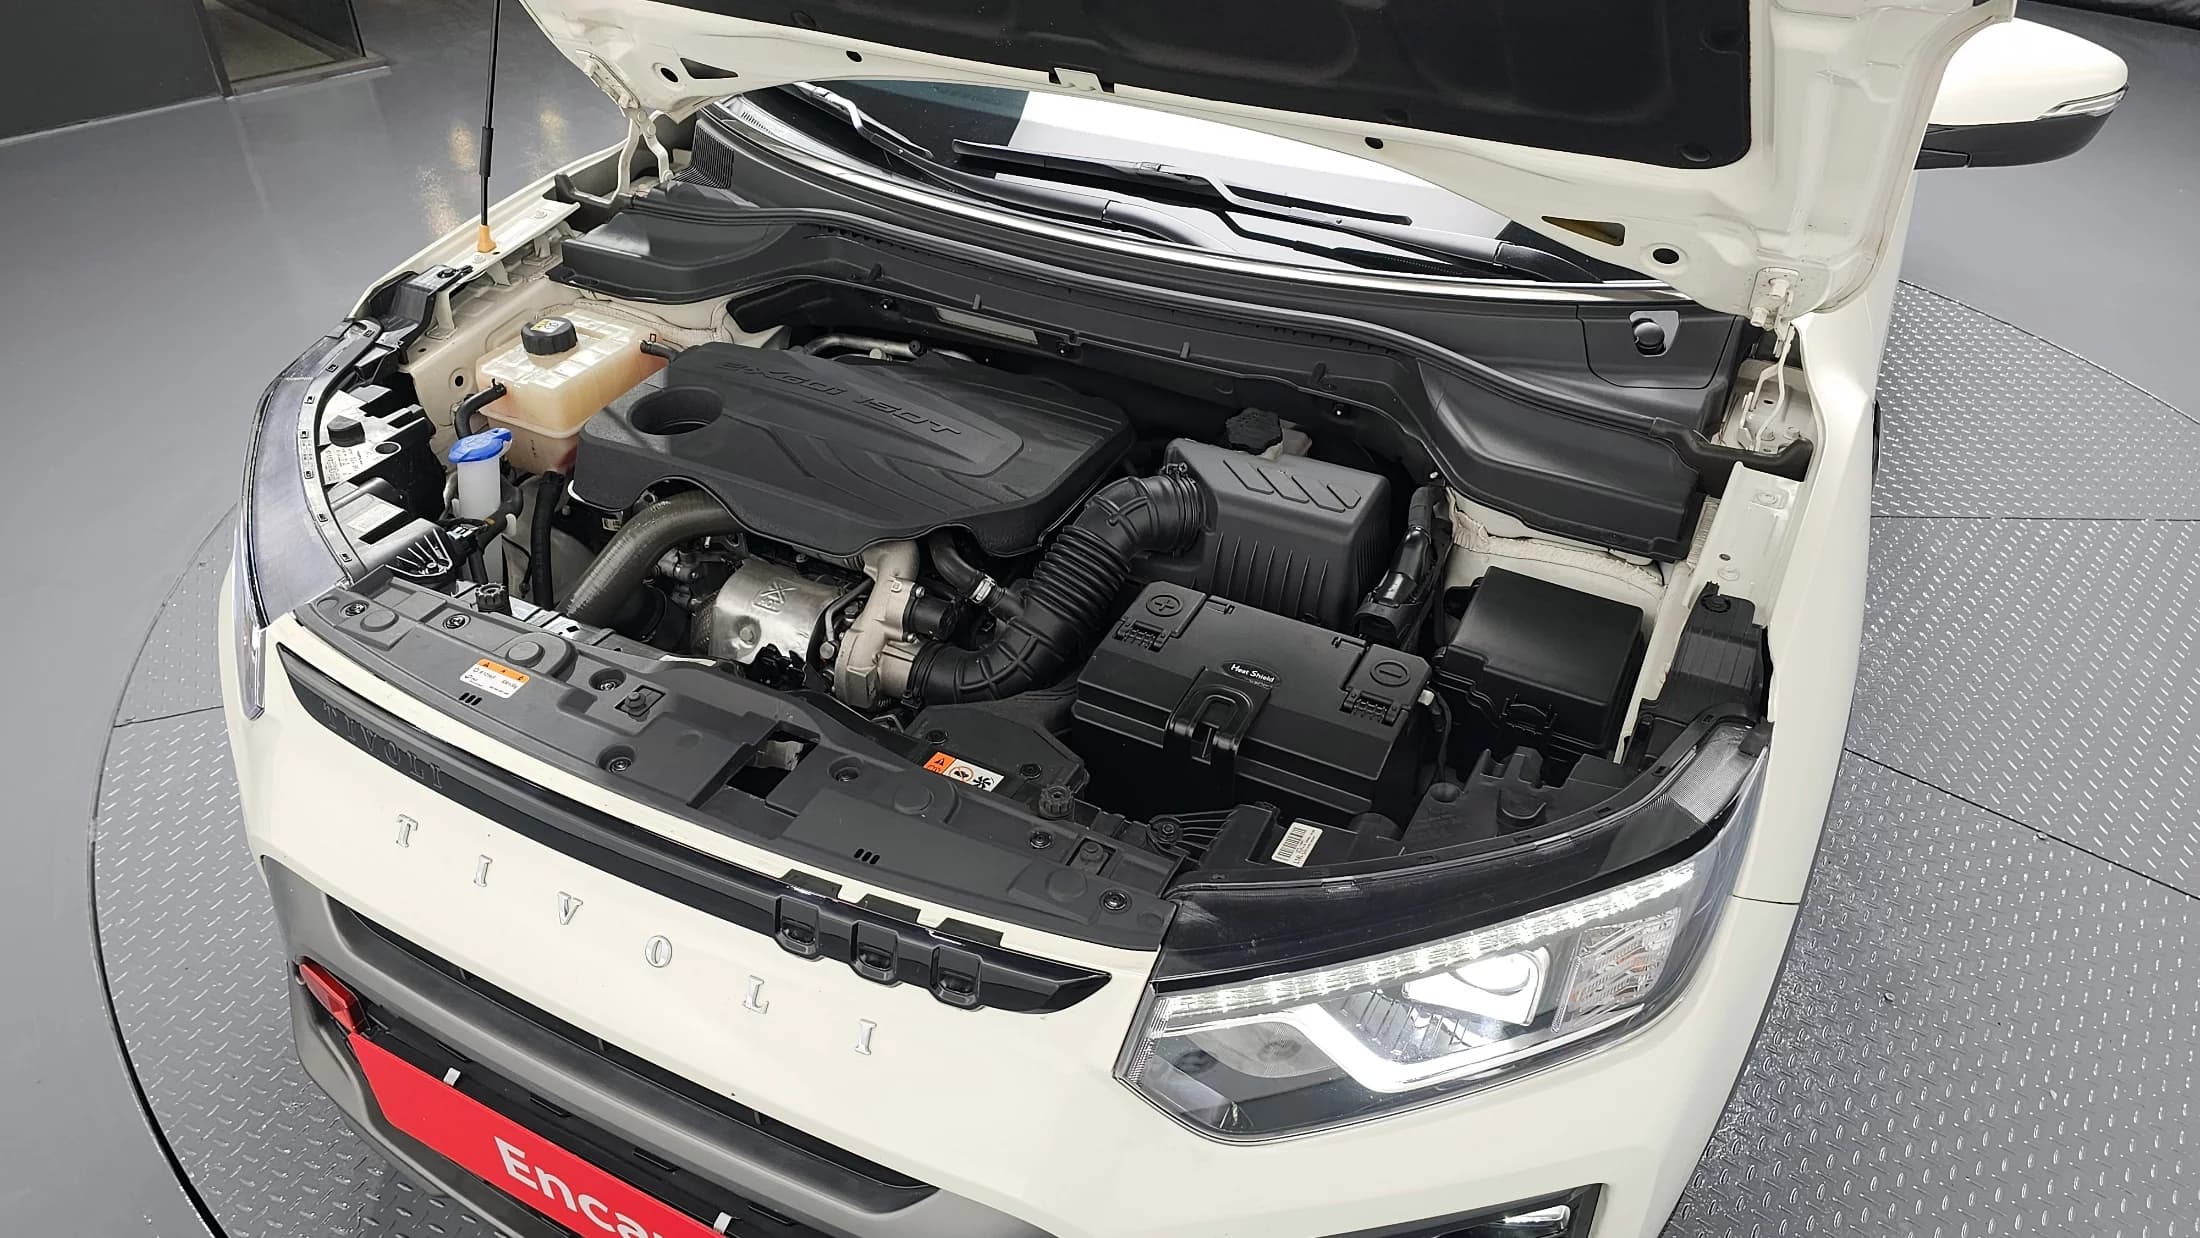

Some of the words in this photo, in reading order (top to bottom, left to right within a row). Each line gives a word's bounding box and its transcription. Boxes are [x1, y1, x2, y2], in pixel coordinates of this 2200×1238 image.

[1231, 664, 1250, 676] Heat
[1250, 671, 1275, 683] Shield
[322, 700, 443, 789] TIVOLI
[395, 813, 878, 1056] TIVOLI
[493, 1135, 664, 1238] Enca
